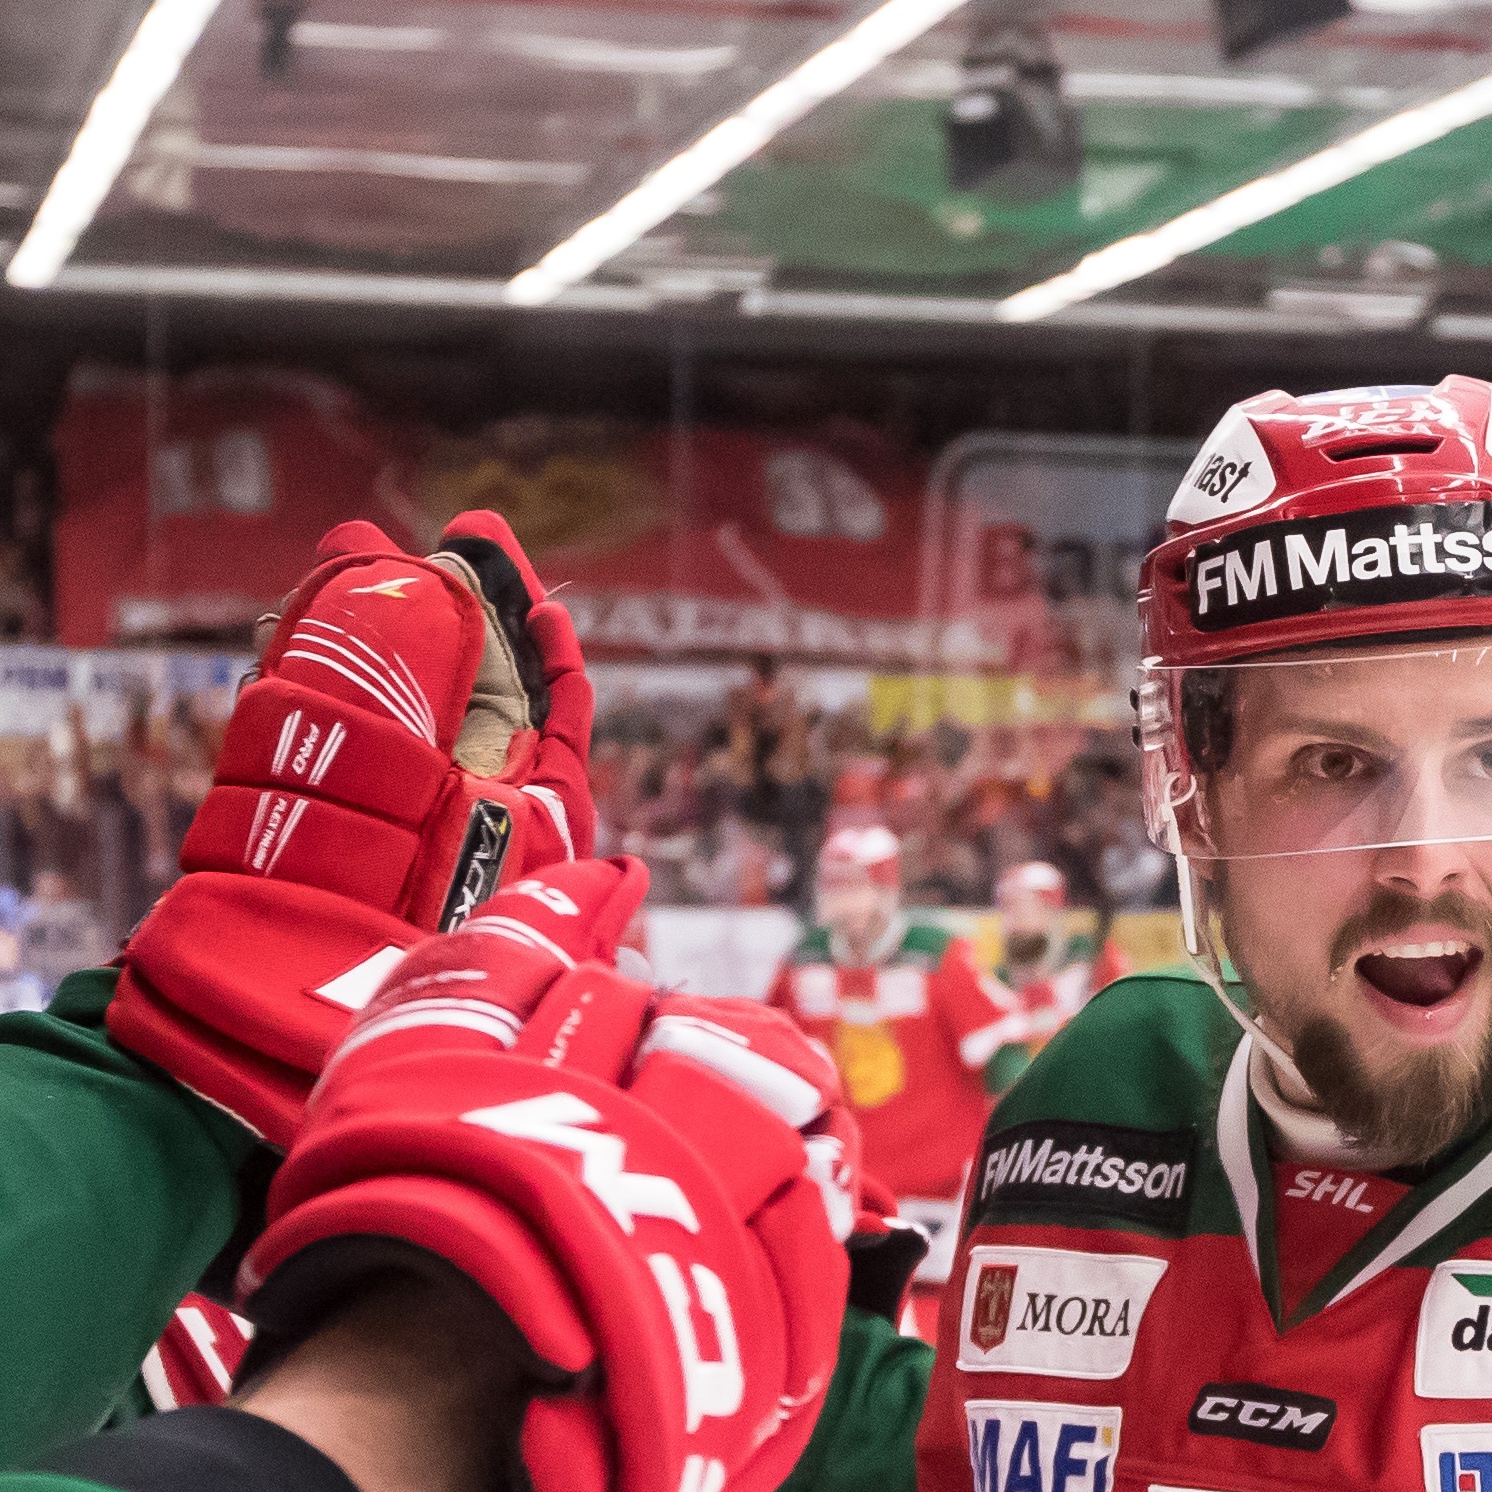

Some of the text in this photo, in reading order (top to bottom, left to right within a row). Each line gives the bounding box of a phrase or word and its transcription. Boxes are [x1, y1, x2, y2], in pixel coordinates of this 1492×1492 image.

[1196, 539, 1277, 615] FM
[1008, 1138, 1186, 1199] Mattsson
[1285, 1170, 1375, 1214] SHL
[1016, 1292, 1131, 1337] MORA
[1196, 1396, 1329, 1435] CCM
